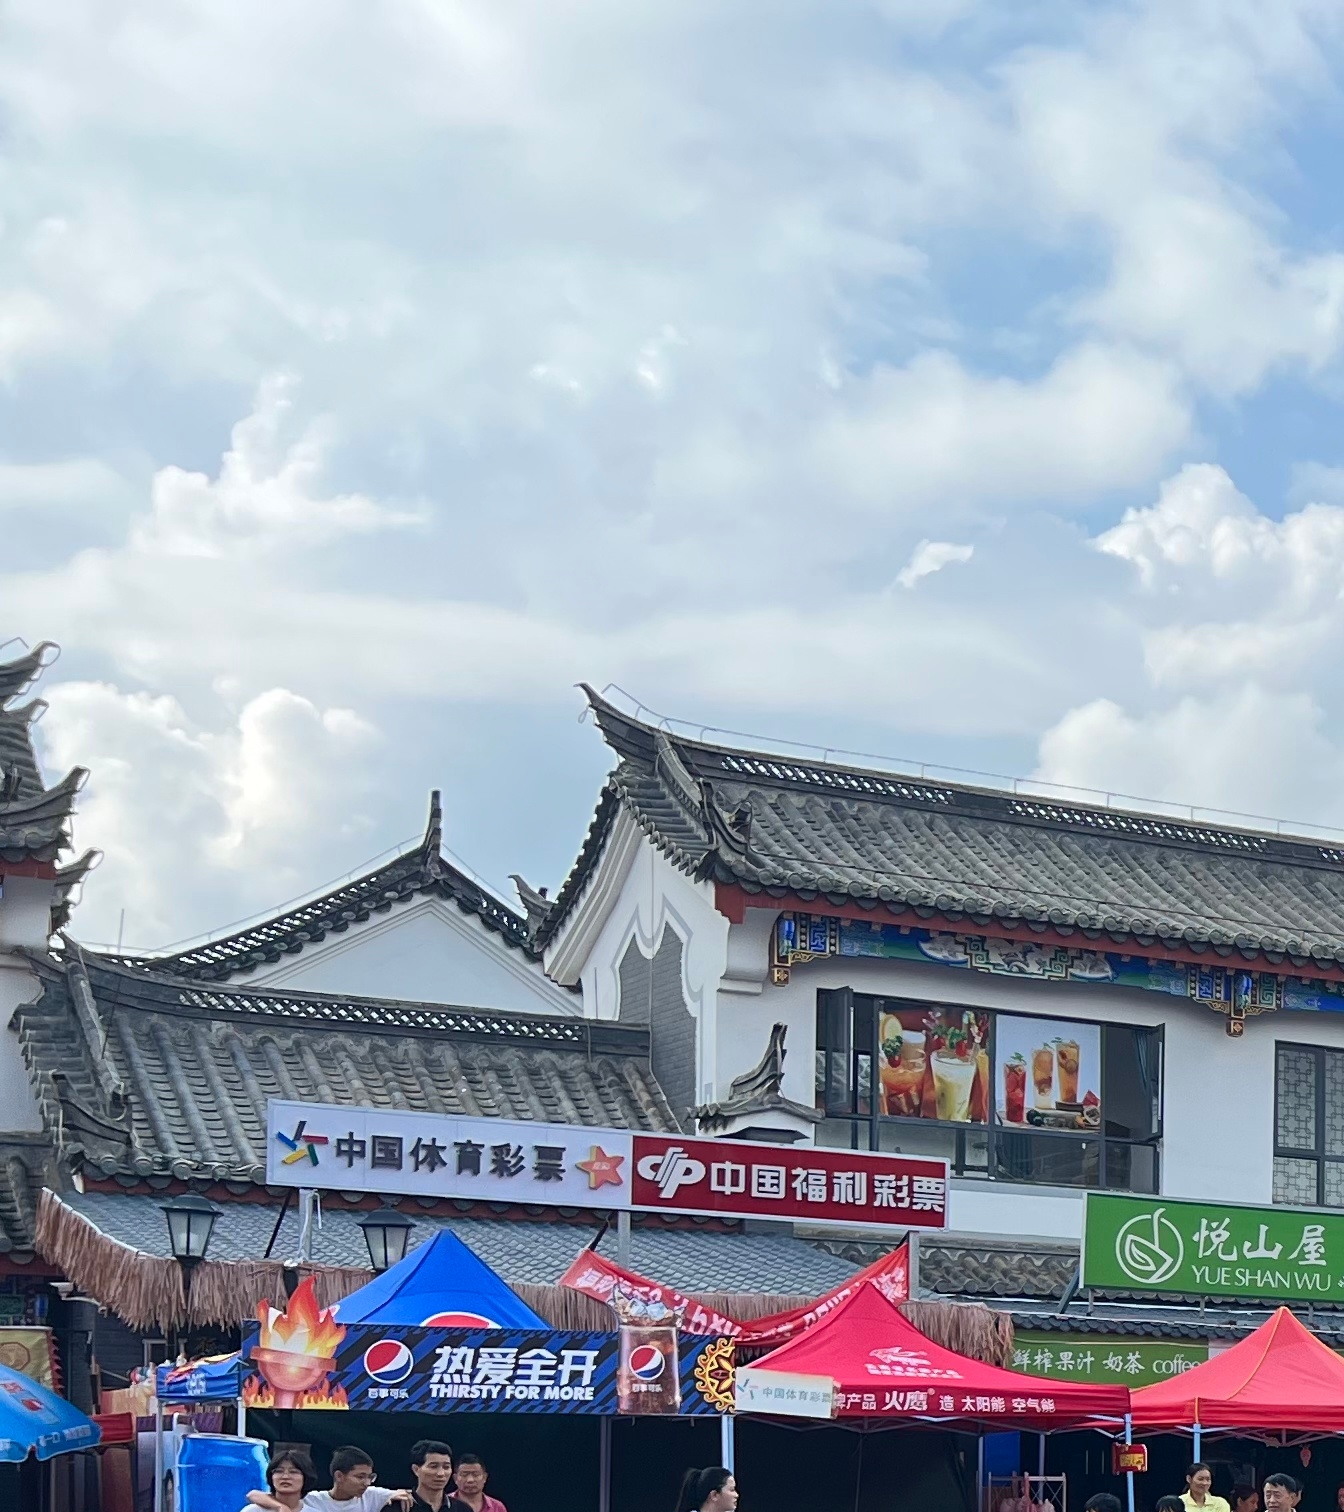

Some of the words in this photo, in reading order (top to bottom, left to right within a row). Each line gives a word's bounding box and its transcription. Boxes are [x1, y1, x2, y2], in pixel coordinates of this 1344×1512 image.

[335, 1131, 567, 1182] 中国体育彩票
[710, 1160, 945, 1212] 中国福利彩票
[1192, 1217, 1327, 1267] 悦山屋
[1192, 1264, 1231, 1286] YUE
[1235, 1268, 1291, 1289] SHAN
[1294, 1271, 1331, 1291] WU
[430, 1345, 600, 1386] 热爱全开
[1012, 1349, 1095, 1374] 鲜榨果汁
[1103, 1351, 1145, 1374] 奶茶
[430, 1384, 502, 1400] THIRSTY
[506, 1386, 540, 1400] FOR
[543, 1387, 594, 1401] MORE
[939, 1395, 955, 1411] 造
[962, 1397, 1006, 1413] 太阳能
[1012, 1398, 1056, 1413] 空气能
